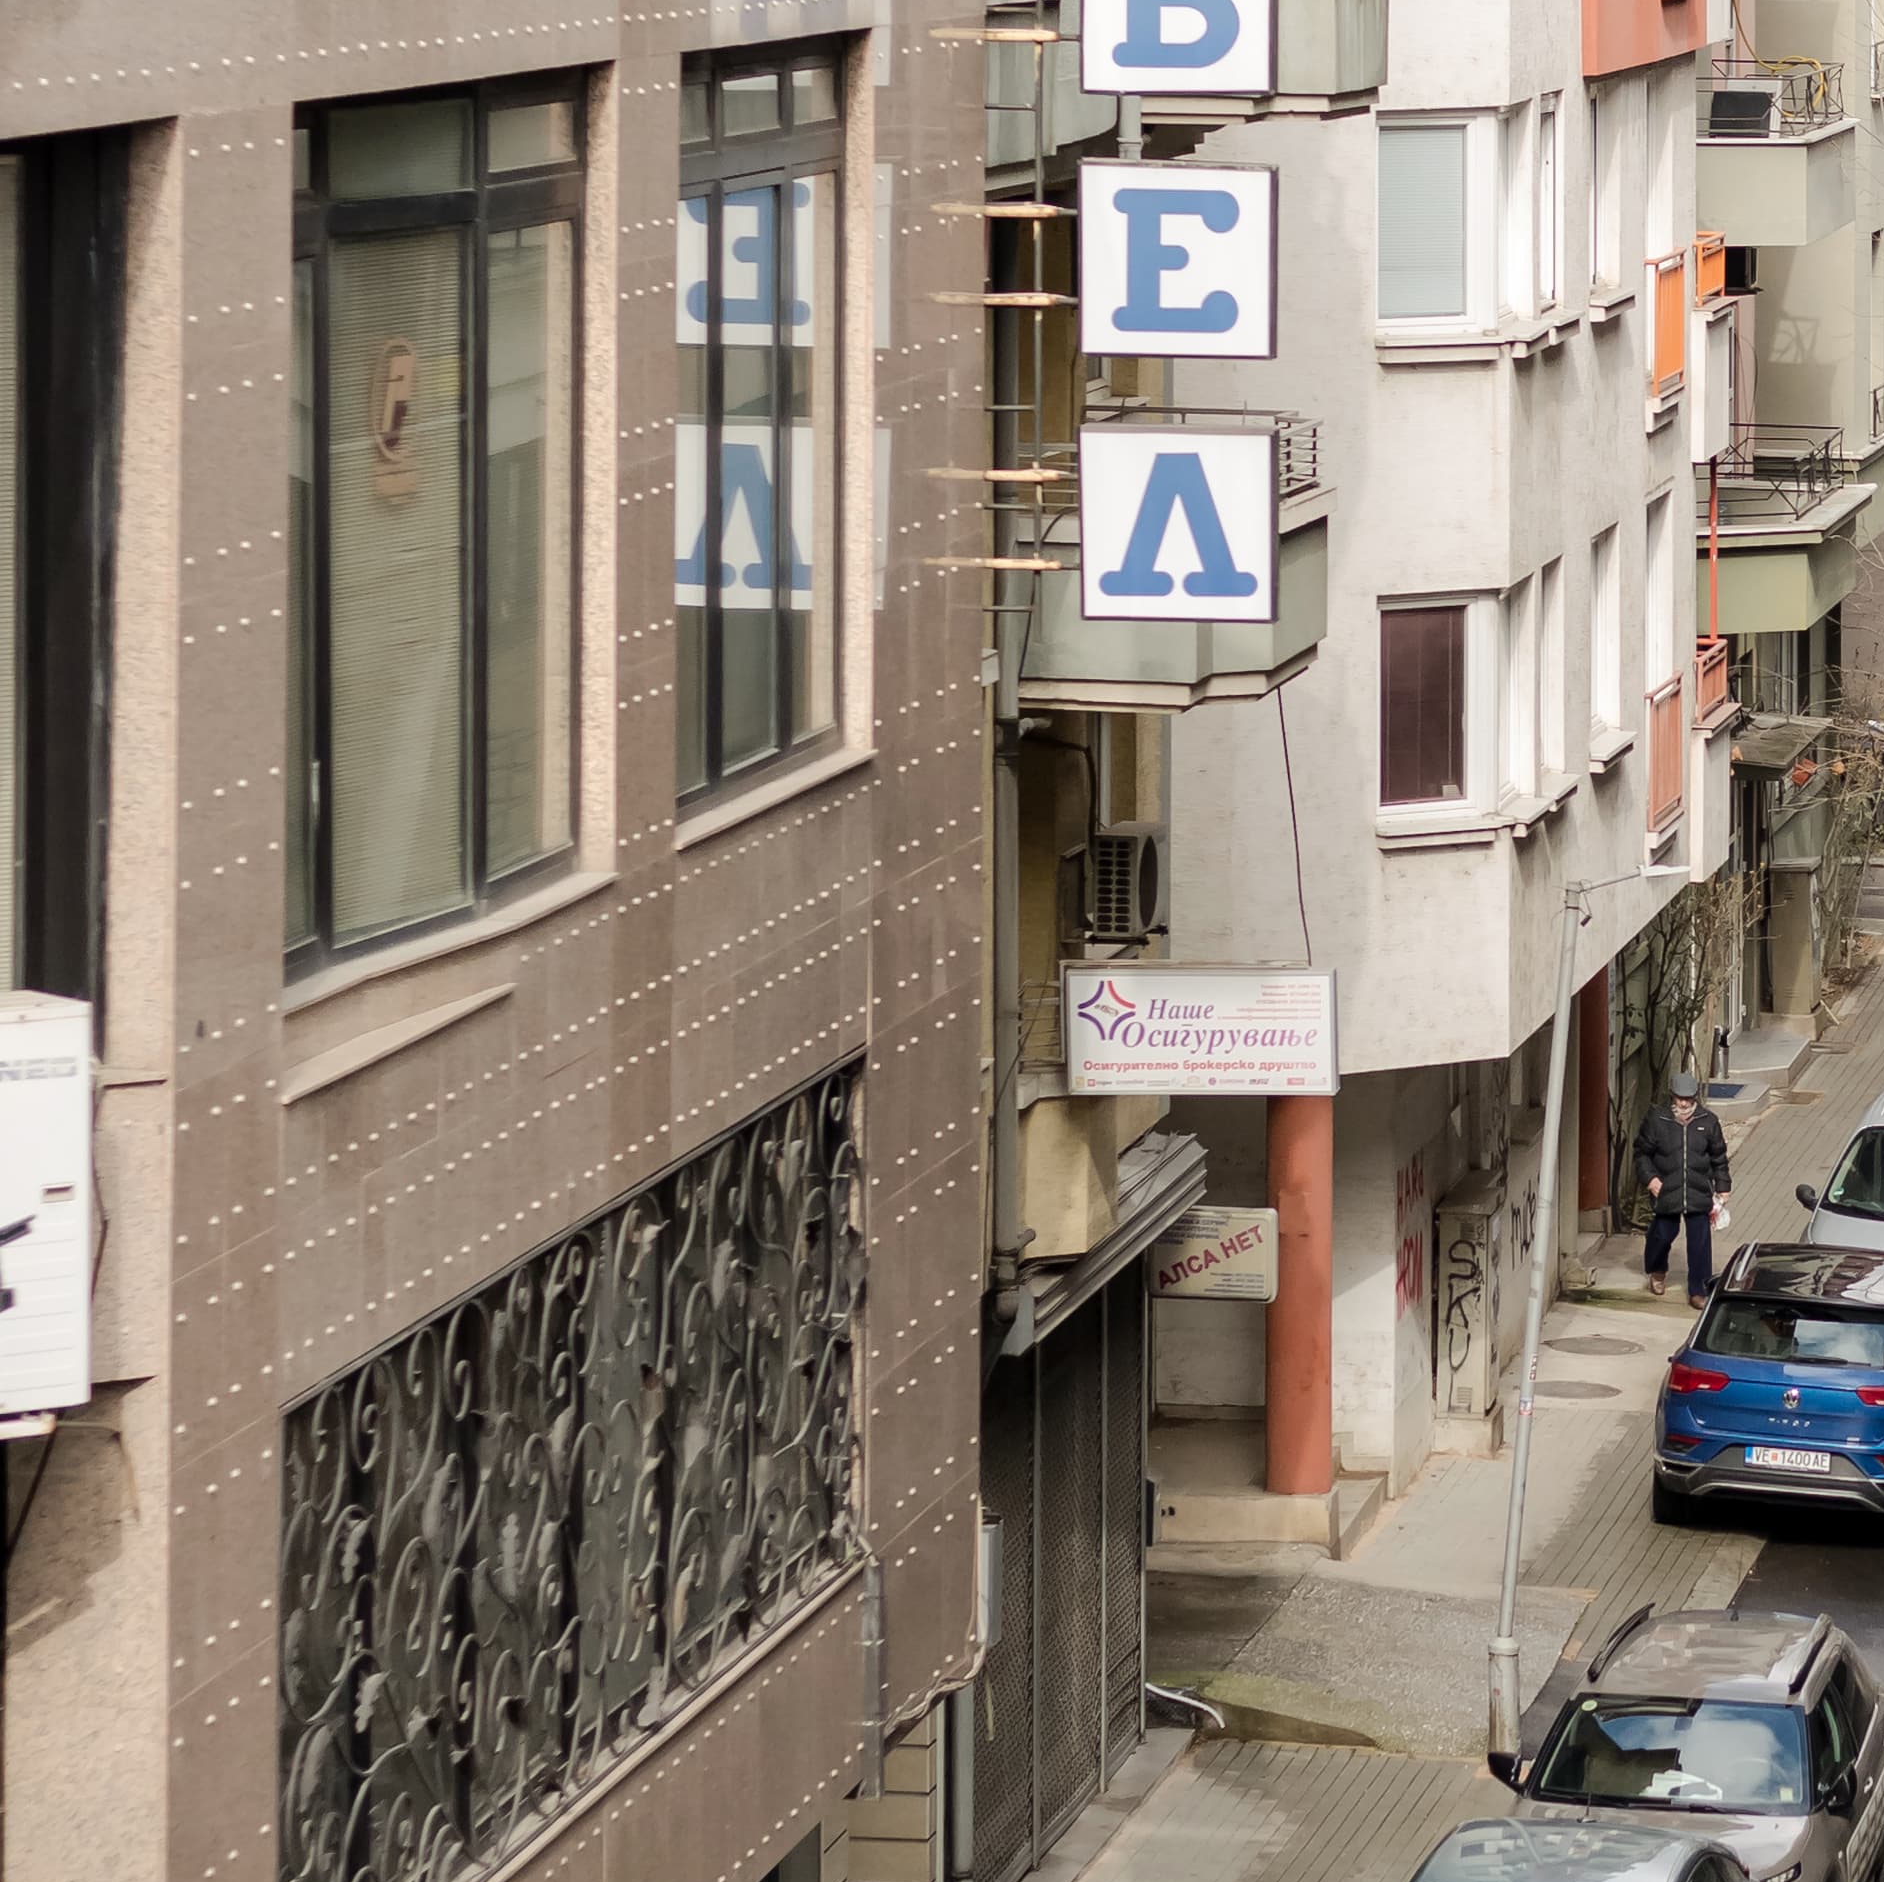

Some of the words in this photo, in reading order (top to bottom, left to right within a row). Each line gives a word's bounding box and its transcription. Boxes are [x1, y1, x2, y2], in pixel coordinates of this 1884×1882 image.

[1147, 999, 1215, 1020] Наше
[1122, 1021, 1318, 1054] Осигурување
[1083, 1060, 1179, 1072] Осигурително
[1183, 1059, 1255, 1072] брокерско
[1158, 1249, 1221, 1290] АЛСА
[1219, 1224, 1263, 1259] НЕТ
[1754, 1449, 1769, 1463] VE
